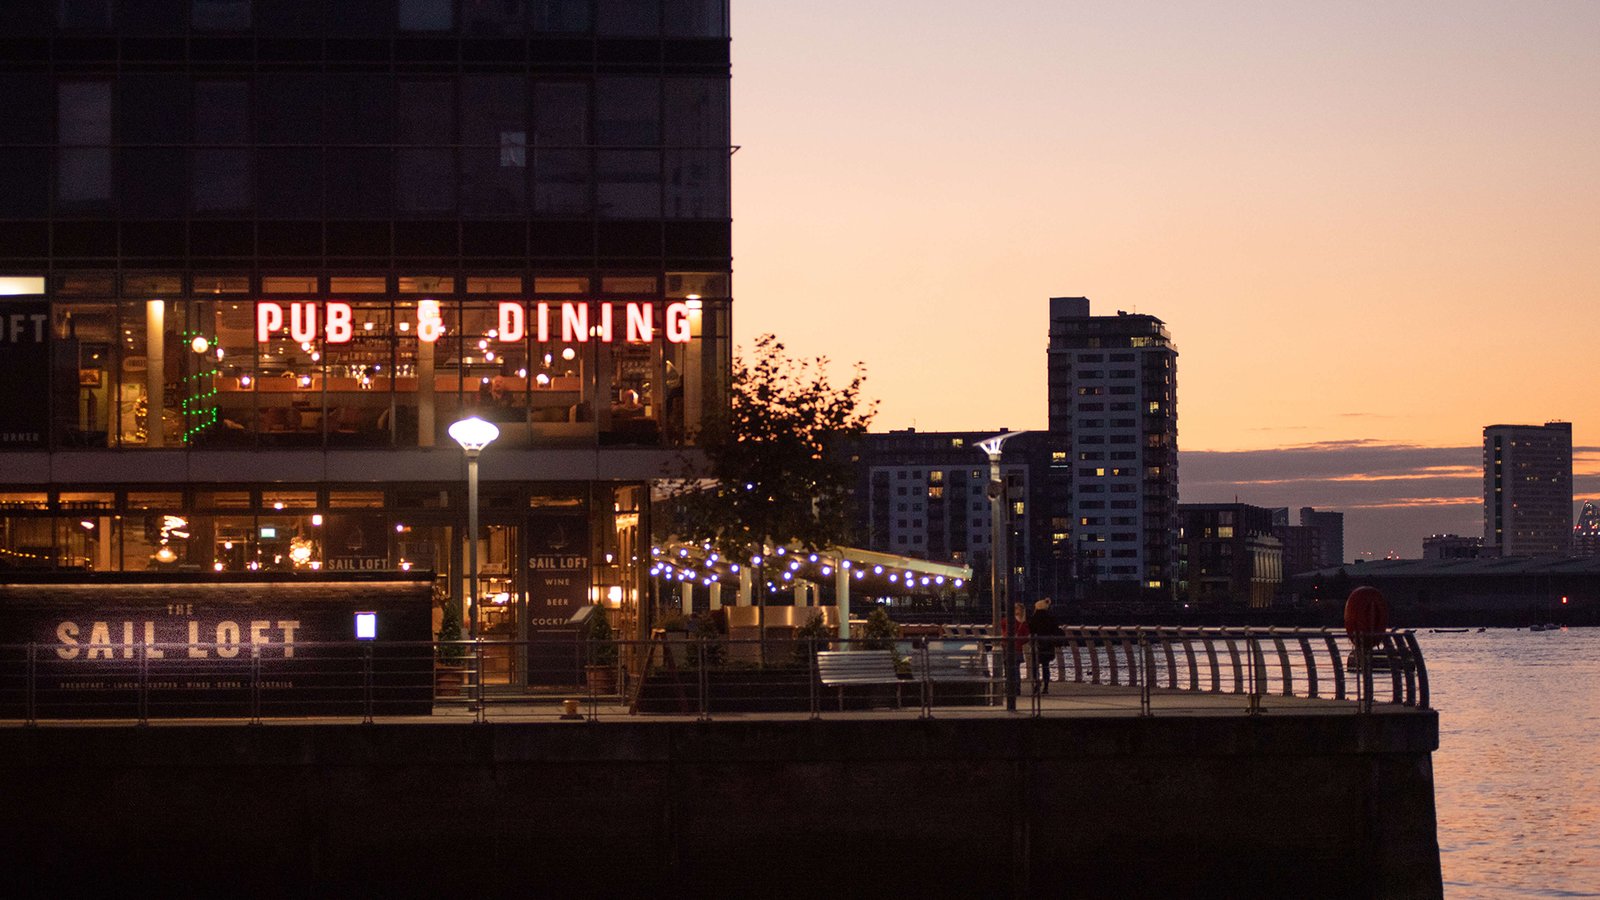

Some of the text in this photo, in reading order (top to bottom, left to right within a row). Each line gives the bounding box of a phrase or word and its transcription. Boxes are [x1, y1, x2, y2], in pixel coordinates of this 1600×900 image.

[257, 302, 691, 343] PUB & DINING
[328, 559, 388, 570] SAIL LOFT
[528, 557, 589, 569] SAIL LOFT
[544, 578, 570, 586] WINE
[546, 598, 569, 606] BEER
[168, 604, 193, 615] THE
[56, 621, 300, 659] SAIL LOFT
